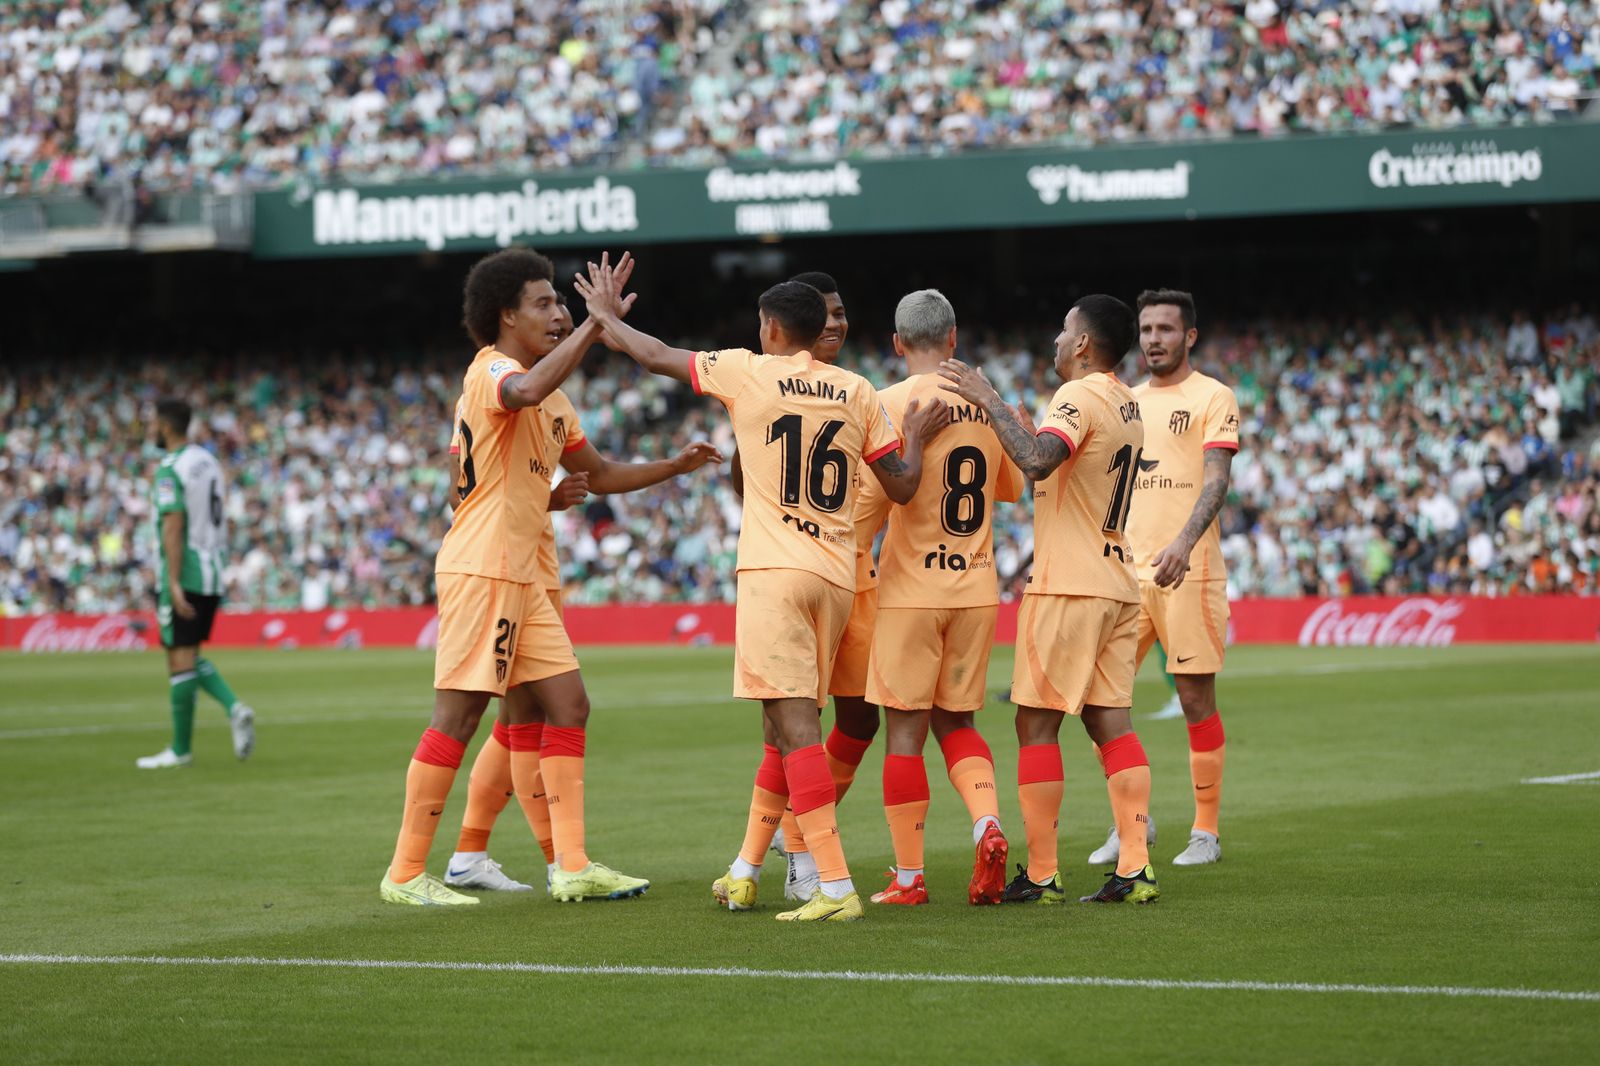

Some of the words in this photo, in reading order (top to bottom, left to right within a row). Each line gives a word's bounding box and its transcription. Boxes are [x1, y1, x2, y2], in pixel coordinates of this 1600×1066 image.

[1067, 162, 1188, 202] hummel
[1369, 146, 1542, 188] Cruzcampo
[313, 177, 638, 250] Manquepierda
[777, 378, 847, 404] MOLINA
[947, 404, 990, 425] ZMA
[765, 414, 848, 514] 16
[941, 445, 987, 537] 8
[924, 543, 966, 571] ria
[1298, 597, 1466, 648] Coca-Cola
